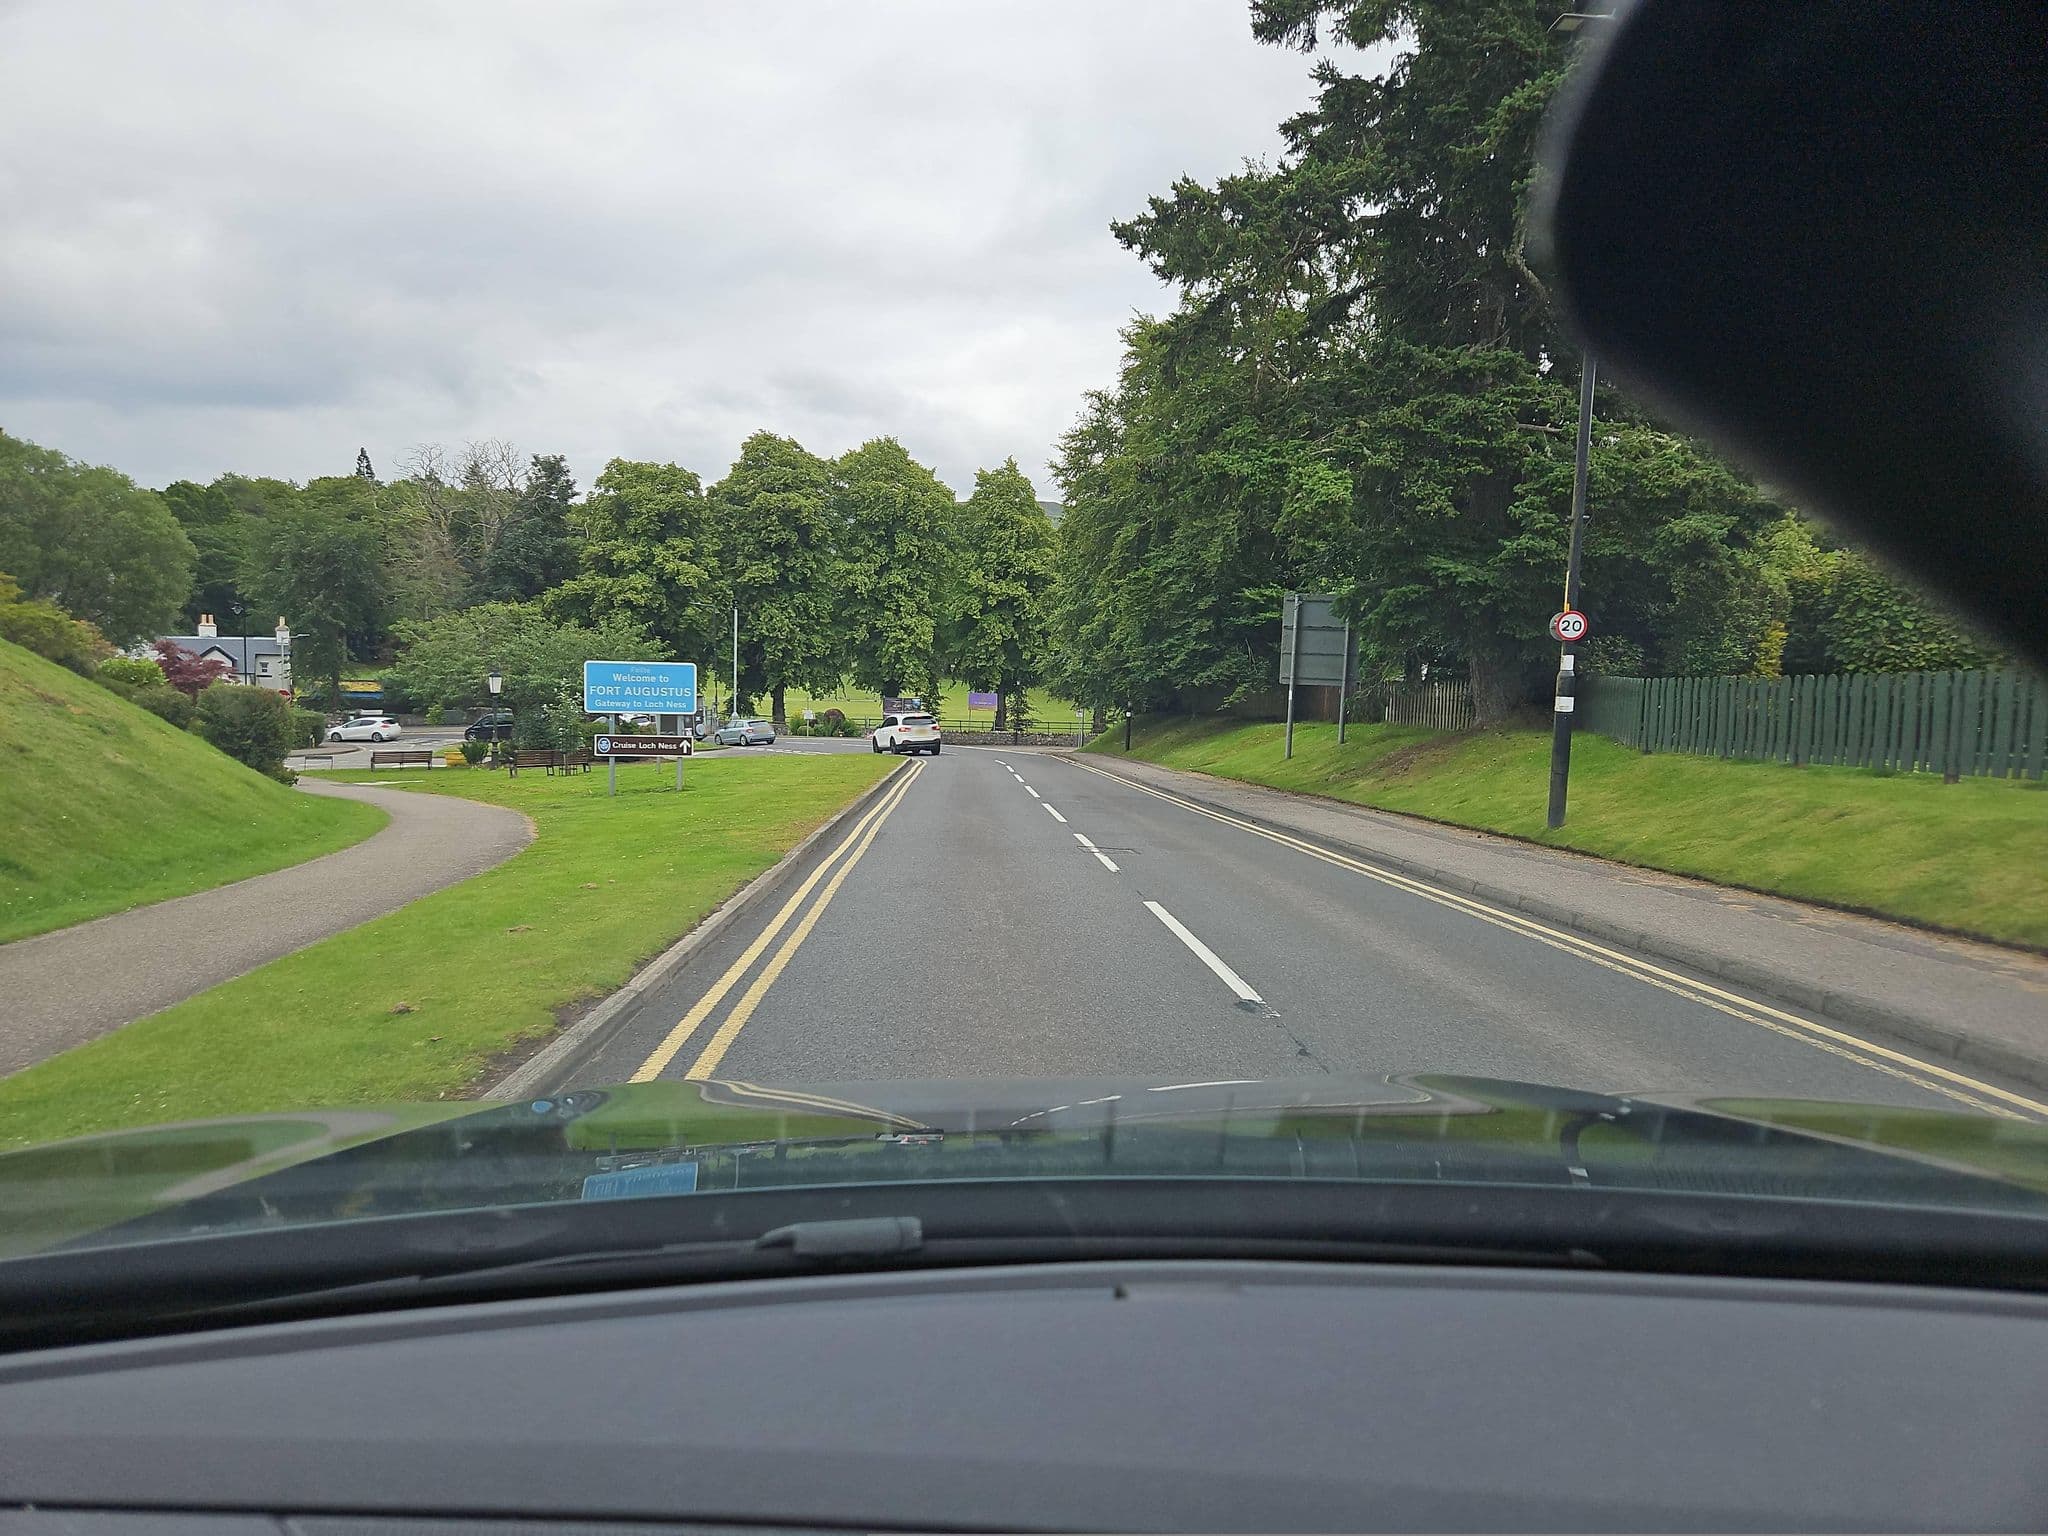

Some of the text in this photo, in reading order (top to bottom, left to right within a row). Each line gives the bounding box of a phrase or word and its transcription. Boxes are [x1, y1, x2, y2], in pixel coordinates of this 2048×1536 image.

[1562, 620, 1582, 632] 20
[613, 673, 669, 683] Welcome to
[590, 686, 692, 697] FORT AUGUSTUS
[595, 699, 631, 708] Gateway
[645, 700, 663, 708] Loch
[612, 741, 637, 749] Cruise
[639, 741, 656, 749] Loch
